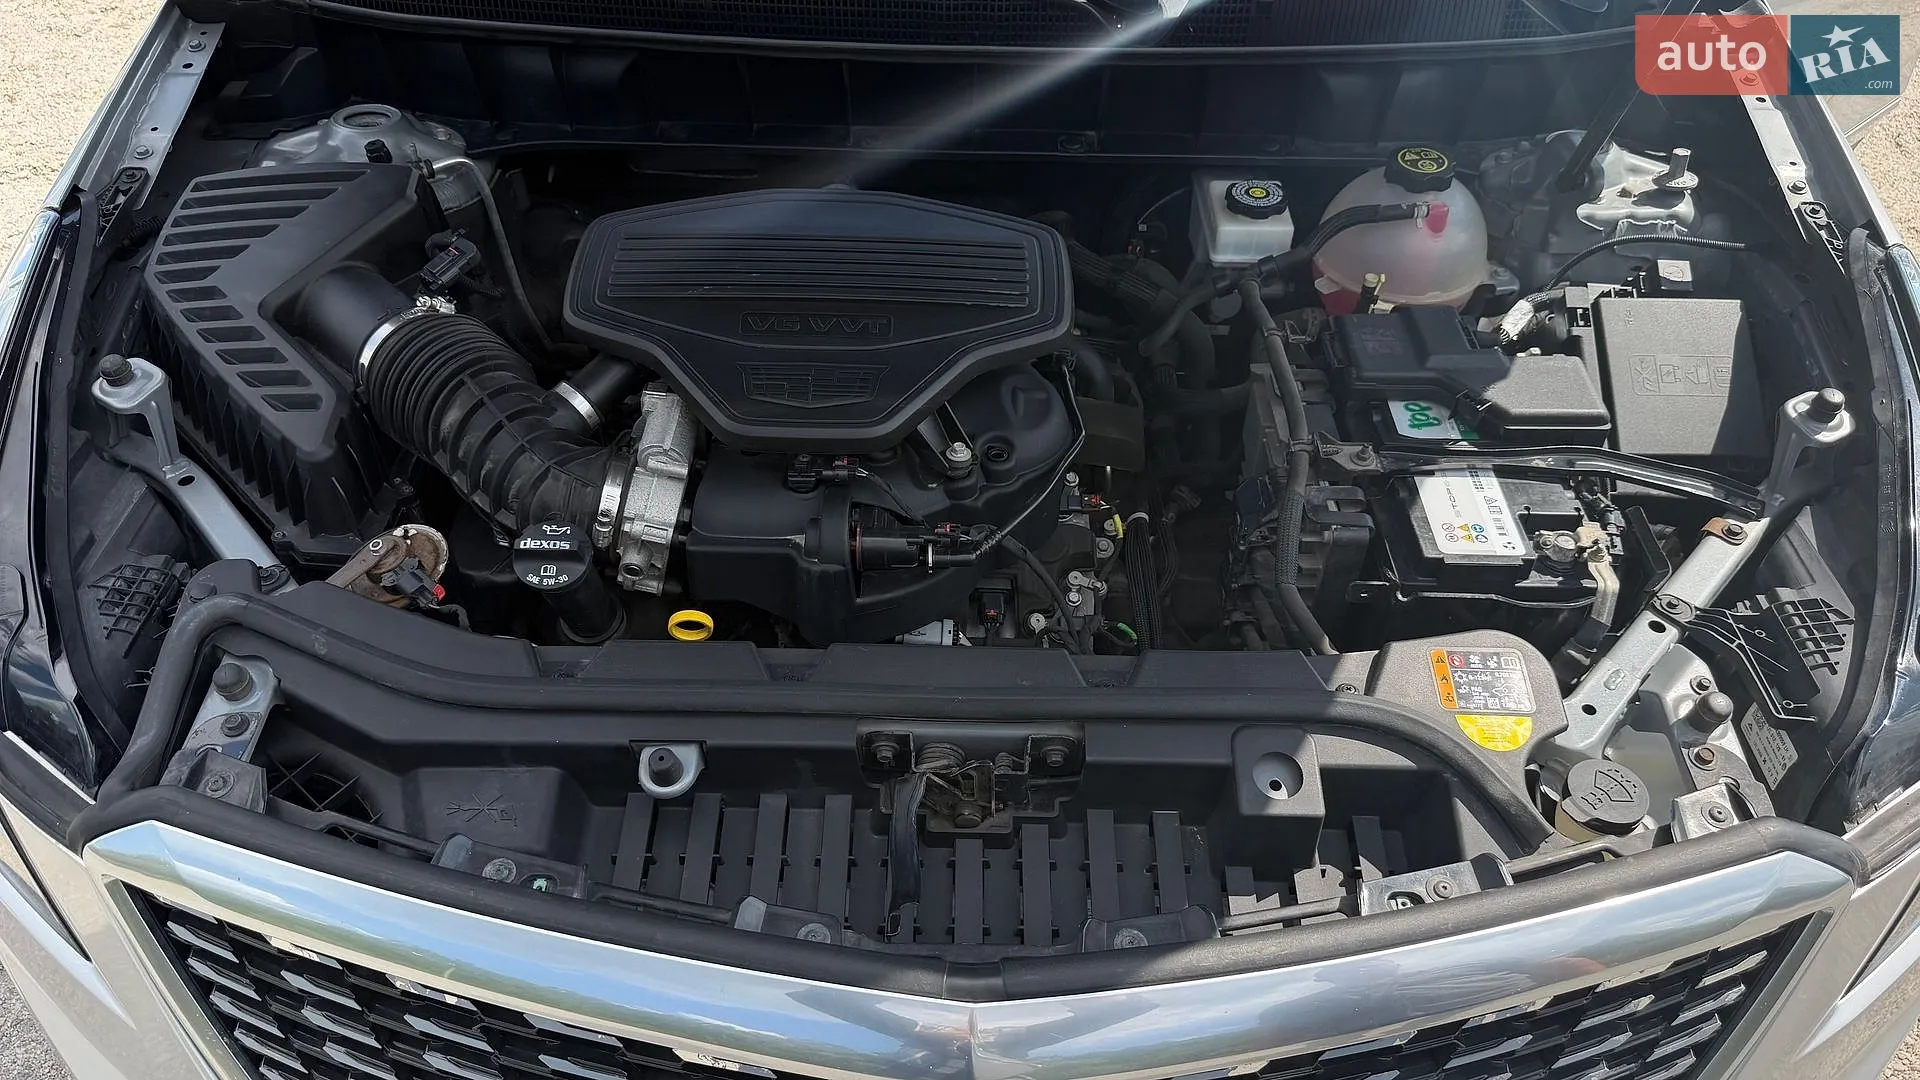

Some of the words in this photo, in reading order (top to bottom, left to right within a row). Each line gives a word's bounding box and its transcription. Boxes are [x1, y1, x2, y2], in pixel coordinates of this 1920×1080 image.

[808, 317, 889, 334] VVT
[519, 537, 571, 550] dexos
[526, 573, 541, 585] SAE
[542, 574, 569, 586] 5W-30
